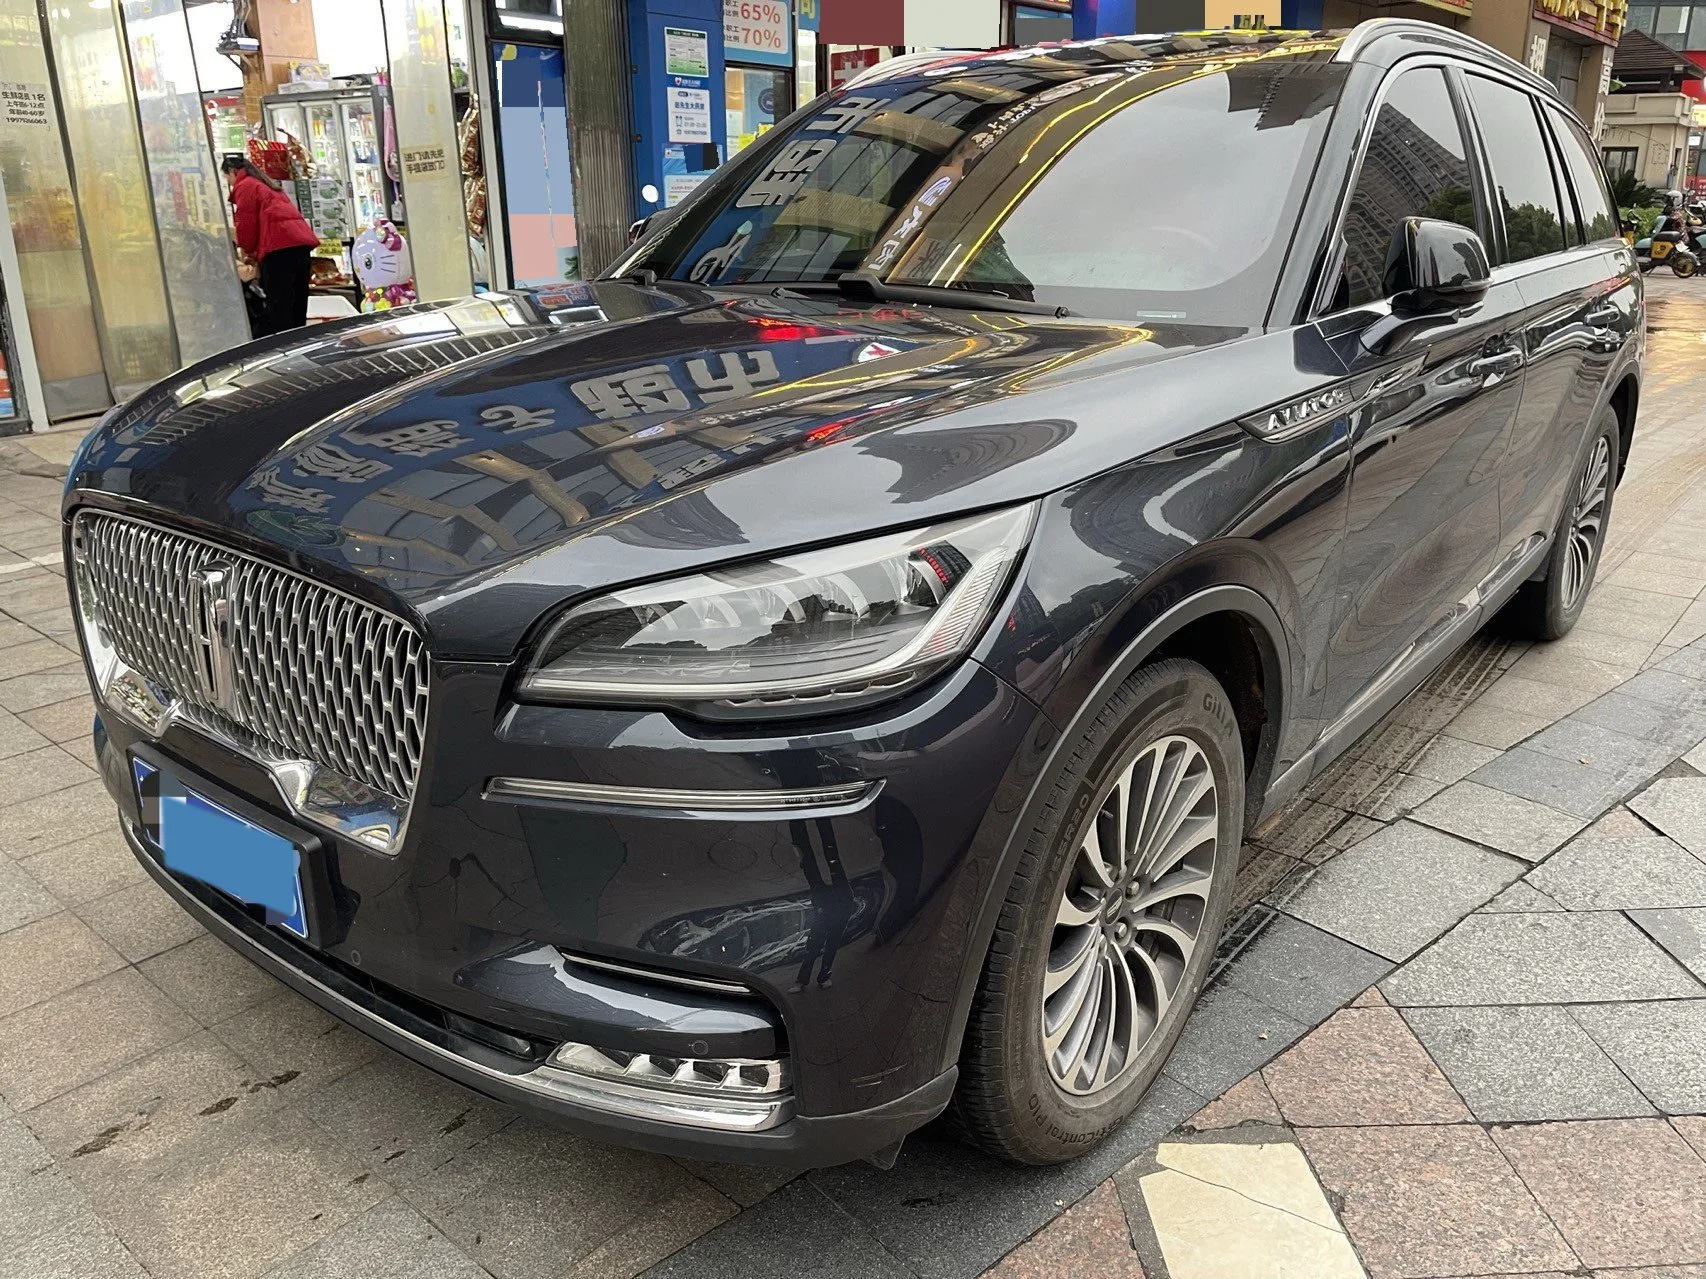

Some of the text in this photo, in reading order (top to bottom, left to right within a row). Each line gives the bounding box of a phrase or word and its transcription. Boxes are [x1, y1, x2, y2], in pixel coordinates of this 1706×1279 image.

[741, 3, 780, 24] 65%
[742, 28, 781, 48] 70%
[1268, 389, 1344, 431] AVIATOR
